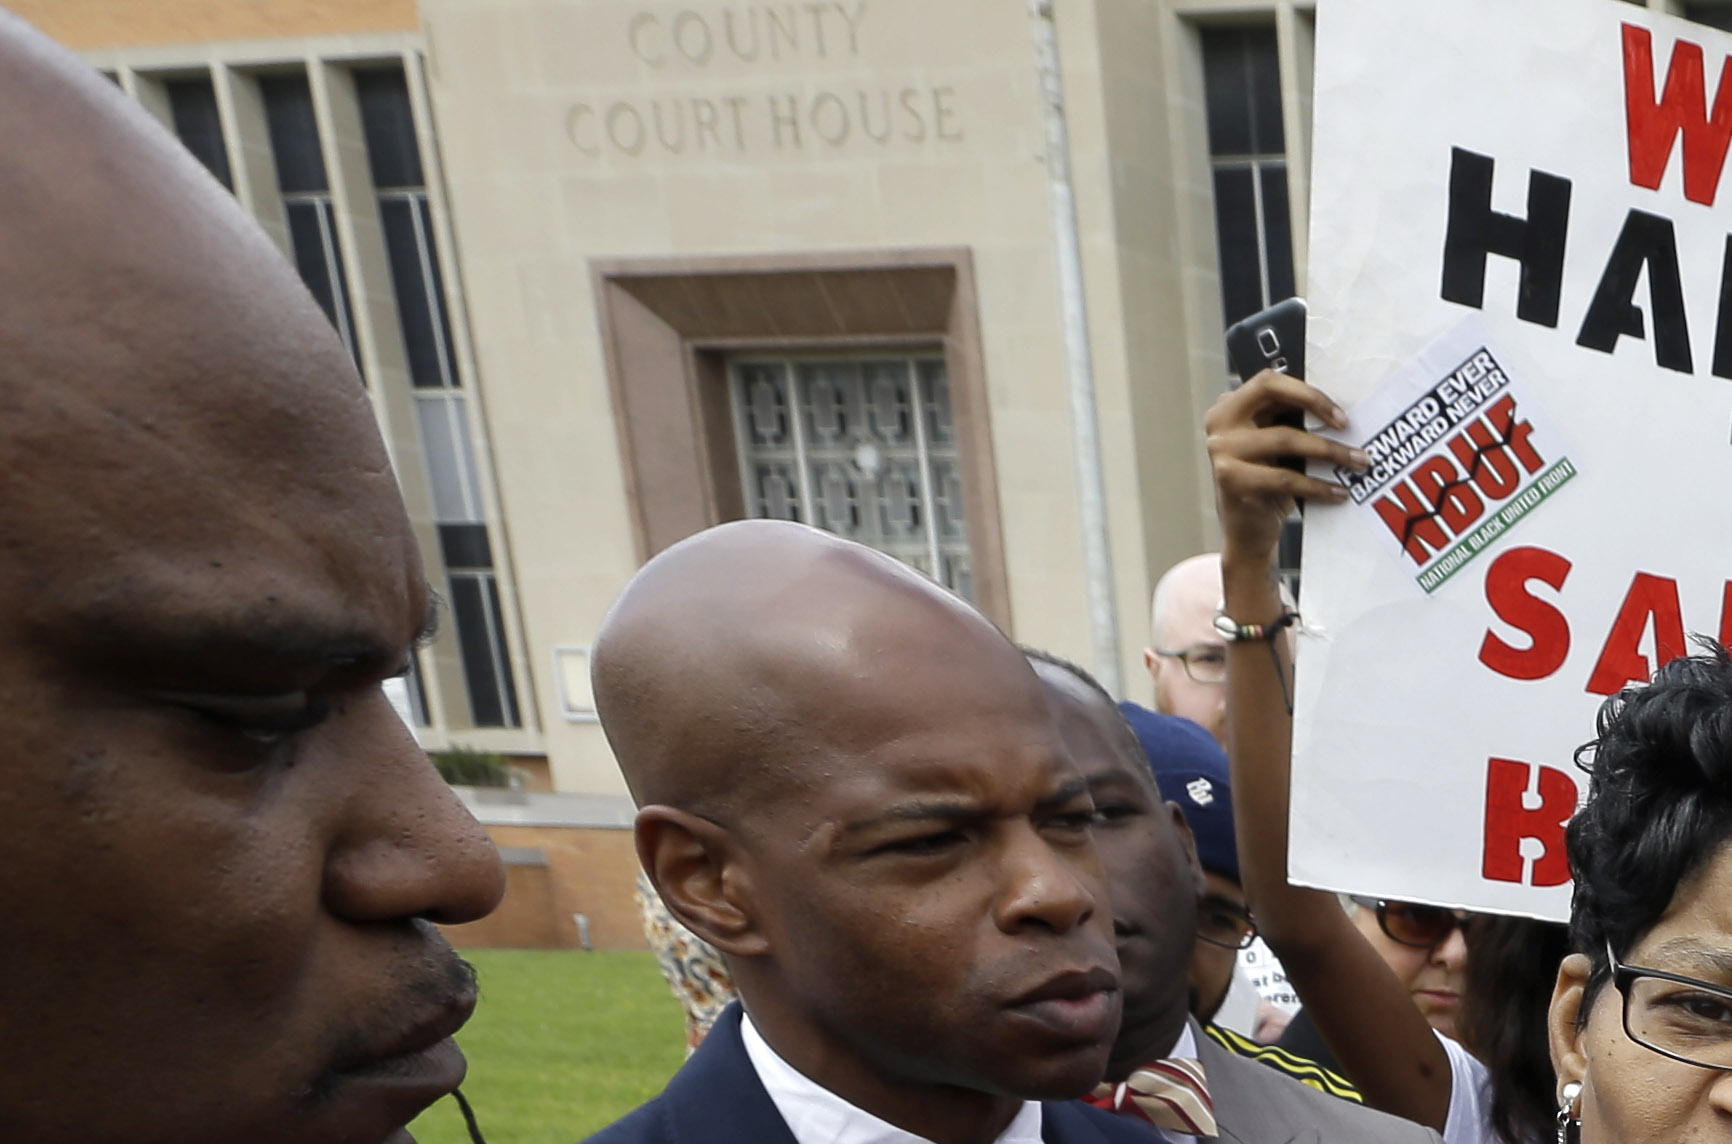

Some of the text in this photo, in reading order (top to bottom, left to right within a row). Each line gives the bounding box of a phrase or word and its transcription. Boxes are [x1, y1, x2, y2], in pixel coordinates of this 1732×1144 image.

[629, 0, 865, 68] COUNTY
[565, 87, 964, 158] COURT HOUSE
[1437, 351, 1495, 405] EVER
[1350, 369, 1506, 501] BACKWARD NEVER
[1372, 392, 1547, 567] NBUF
[1419, 460, 1573, 591] NATIONAL BLACK UNITED FRONT
